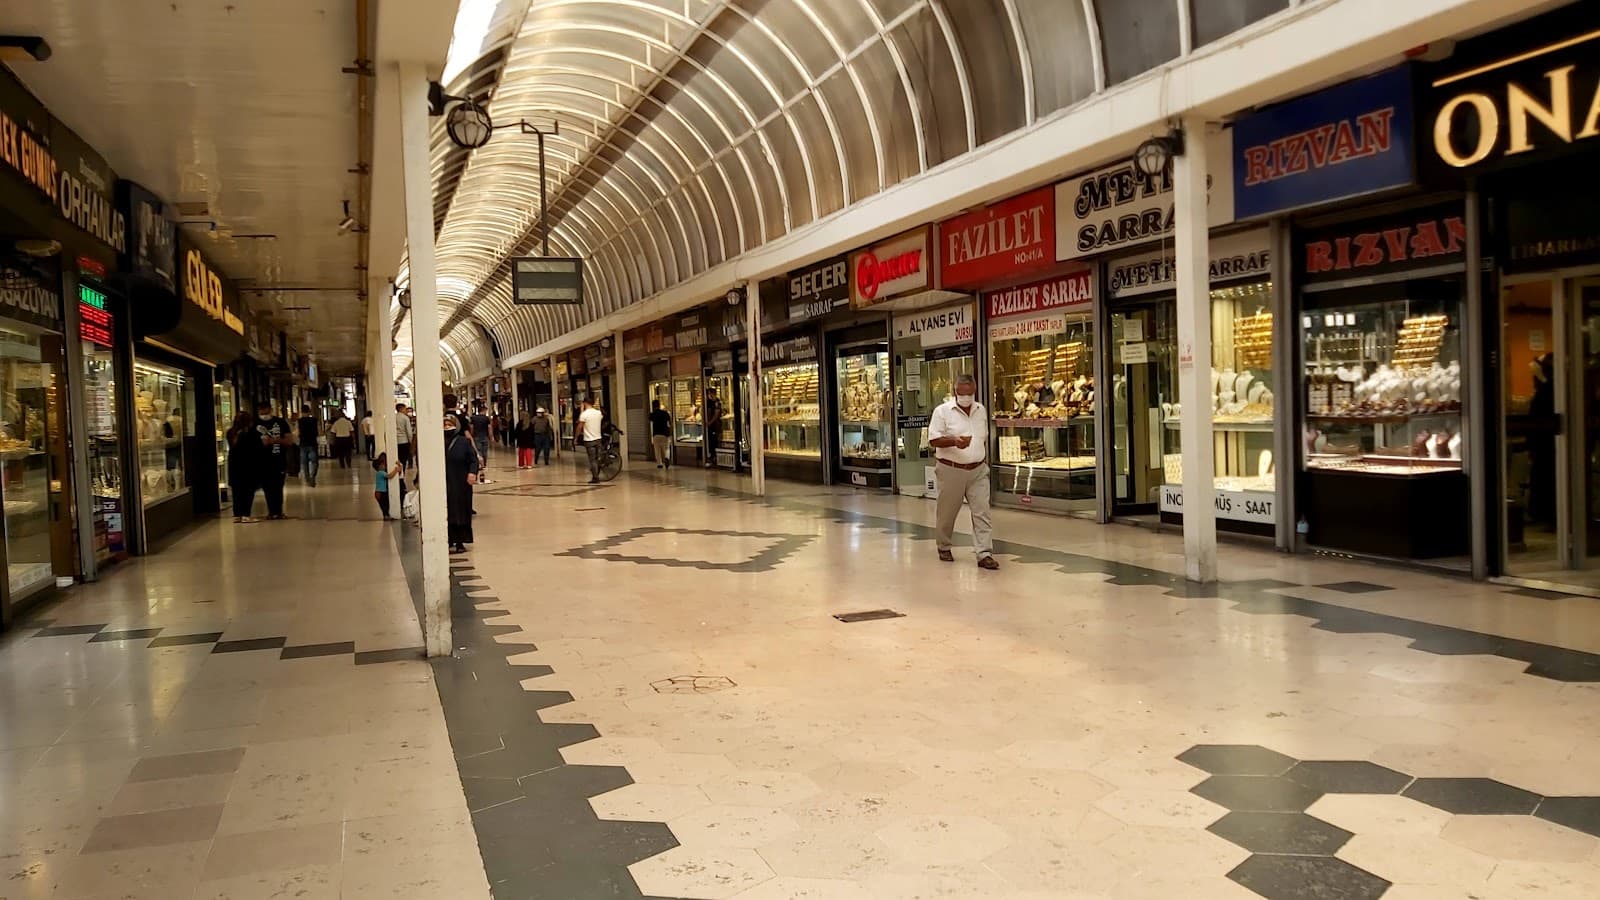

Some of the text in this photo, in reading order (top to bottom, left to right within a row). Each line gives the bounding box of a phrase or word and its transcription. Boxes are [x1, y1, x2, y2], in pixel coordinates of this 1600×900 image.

[1244, 107, 1395, 187] RIZVAN
[60, 170, 127, 254] ORHANLAR
[947, 204, 1044, 266] FAZİLET
[790, 261, 847, 300] SEÇER
[909, 307, 964, 333] ALYANS EVİ
[991, 286, 1038, 316] FAZİLET
[1245, 501, 1273, 516] SAAT
